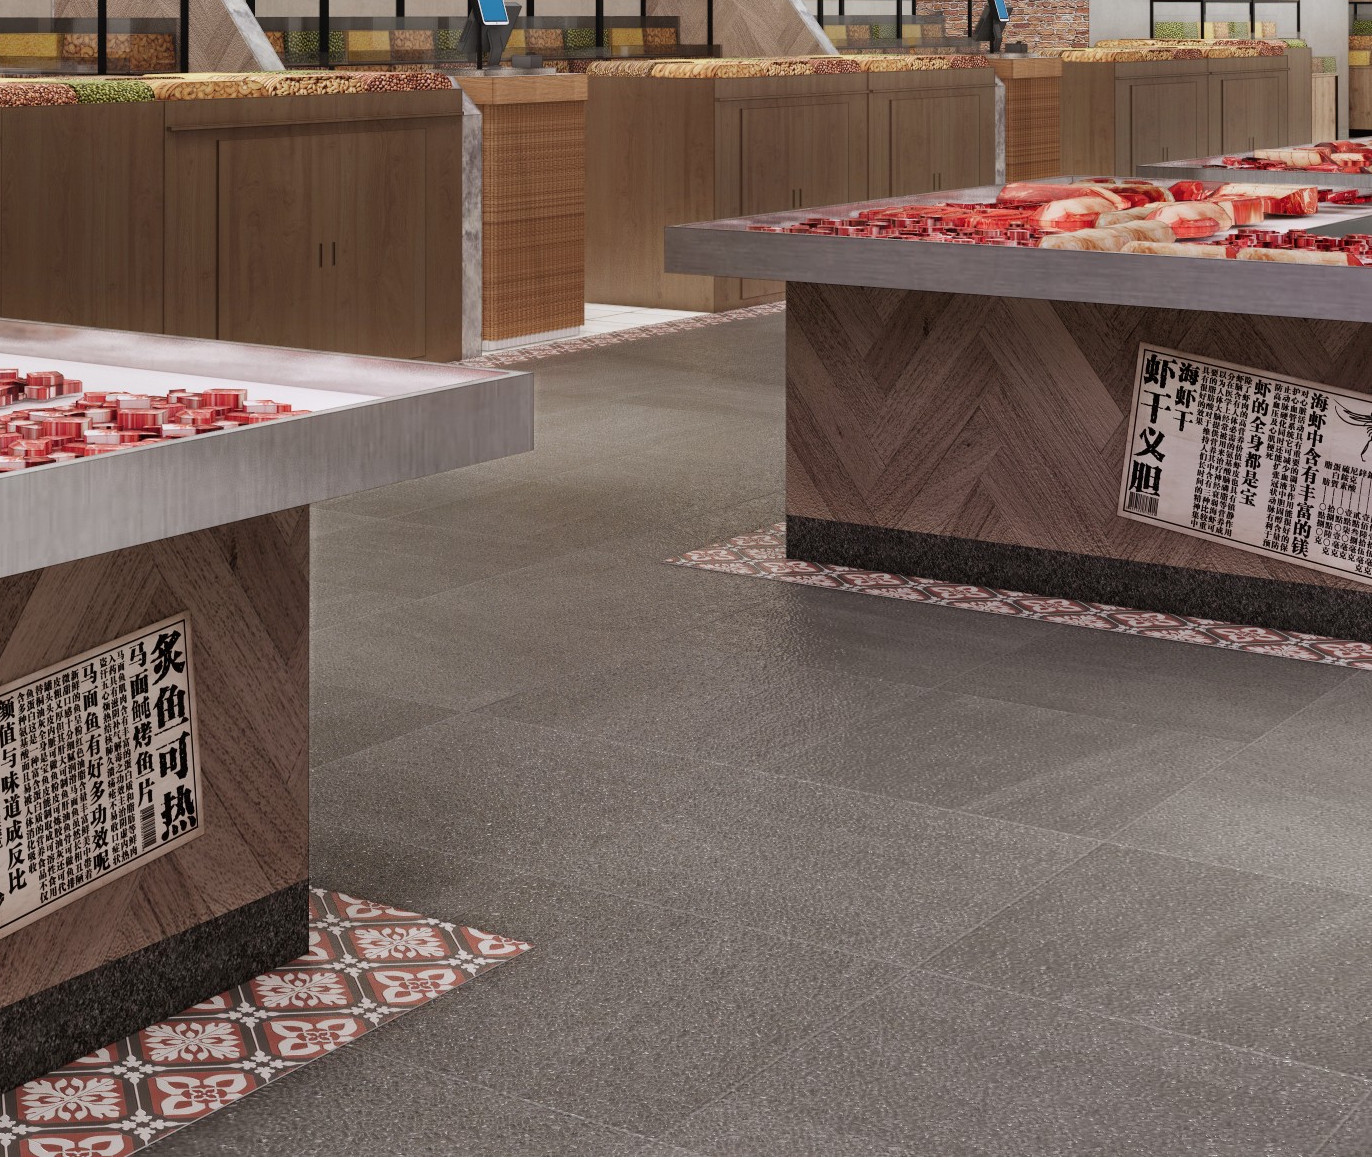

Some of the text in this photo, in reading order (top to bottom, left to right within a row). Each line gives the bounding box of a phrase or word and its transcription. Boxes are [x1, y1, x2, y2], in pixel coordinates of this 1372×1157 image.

[1128, 353, 1178, 498] 虾干义胆
[1172, 361, 1201, 433] 海虾干
[1196, 365, 1210, 426] 具有很好的效果
[1239, 379, 1273, 508] 虾的全身都是宝
[1291, 392, 1330, 558] 海虾中含有丰富的镁
[81, 662, 112, 875] 马面鱼有好多功效呢
[150, 630, 197, 842] 炙鱼可热
